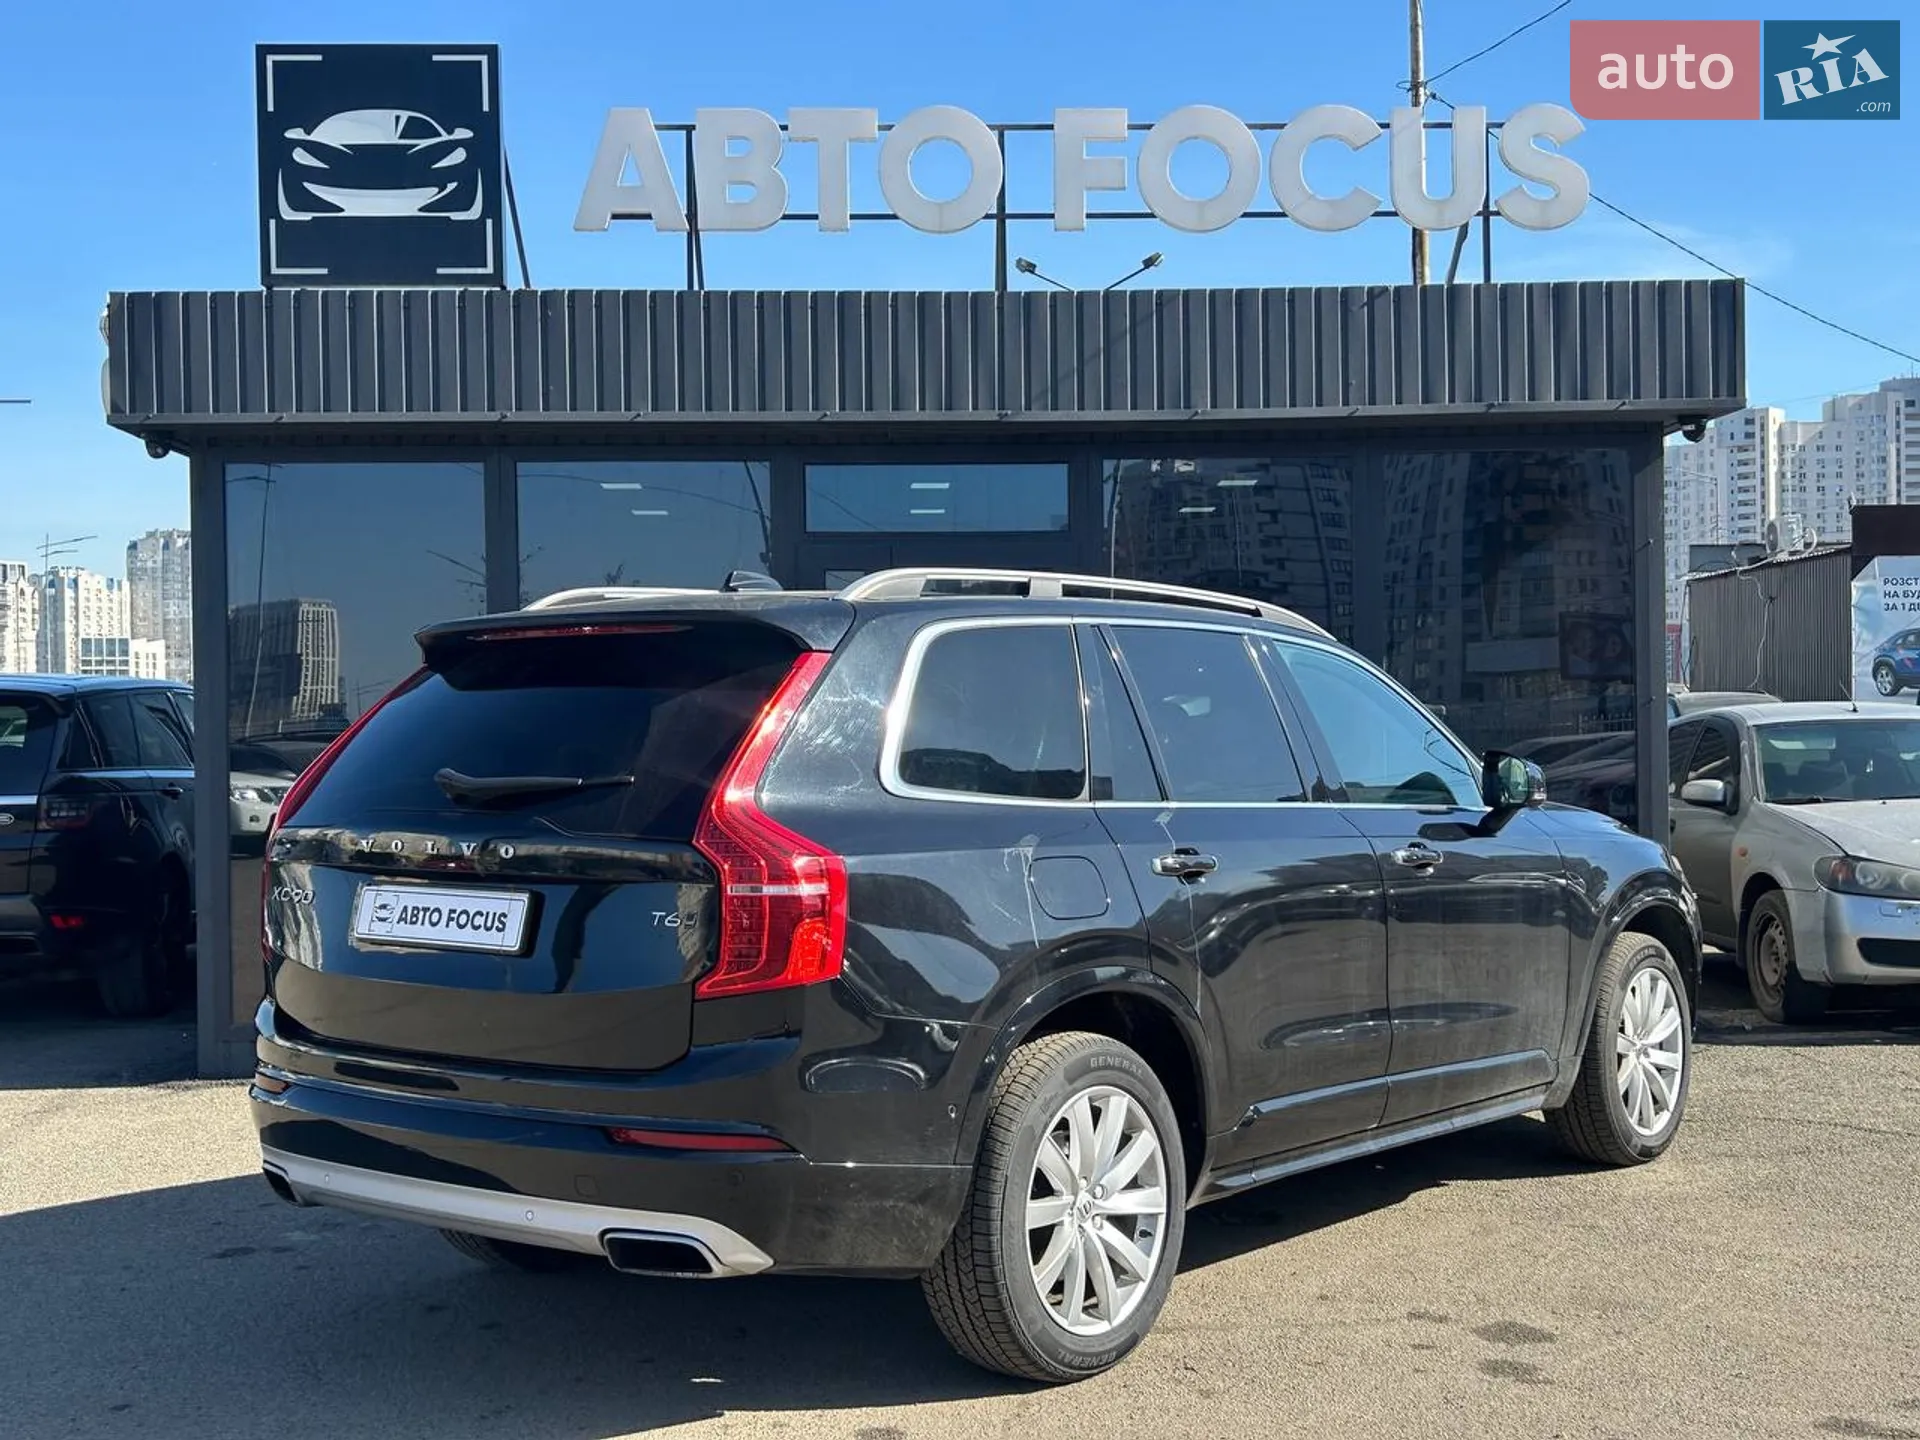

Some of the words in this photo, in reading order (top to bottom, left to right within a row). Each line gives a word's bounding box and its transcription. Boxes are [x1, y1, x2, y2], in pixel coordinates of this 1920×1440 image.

[573, 104, 1004, 234] АВТО
[1054, 103, 1590, 234] FOCUS
[1884, 590, 1900, 599] НА
[360, 839, 515, 859] VOLVO
[272, 886, 313, 904] XC90
[446, 908, 508, 932] FOCUS
[1090, 1056, 1143, 1077] GENERAL
